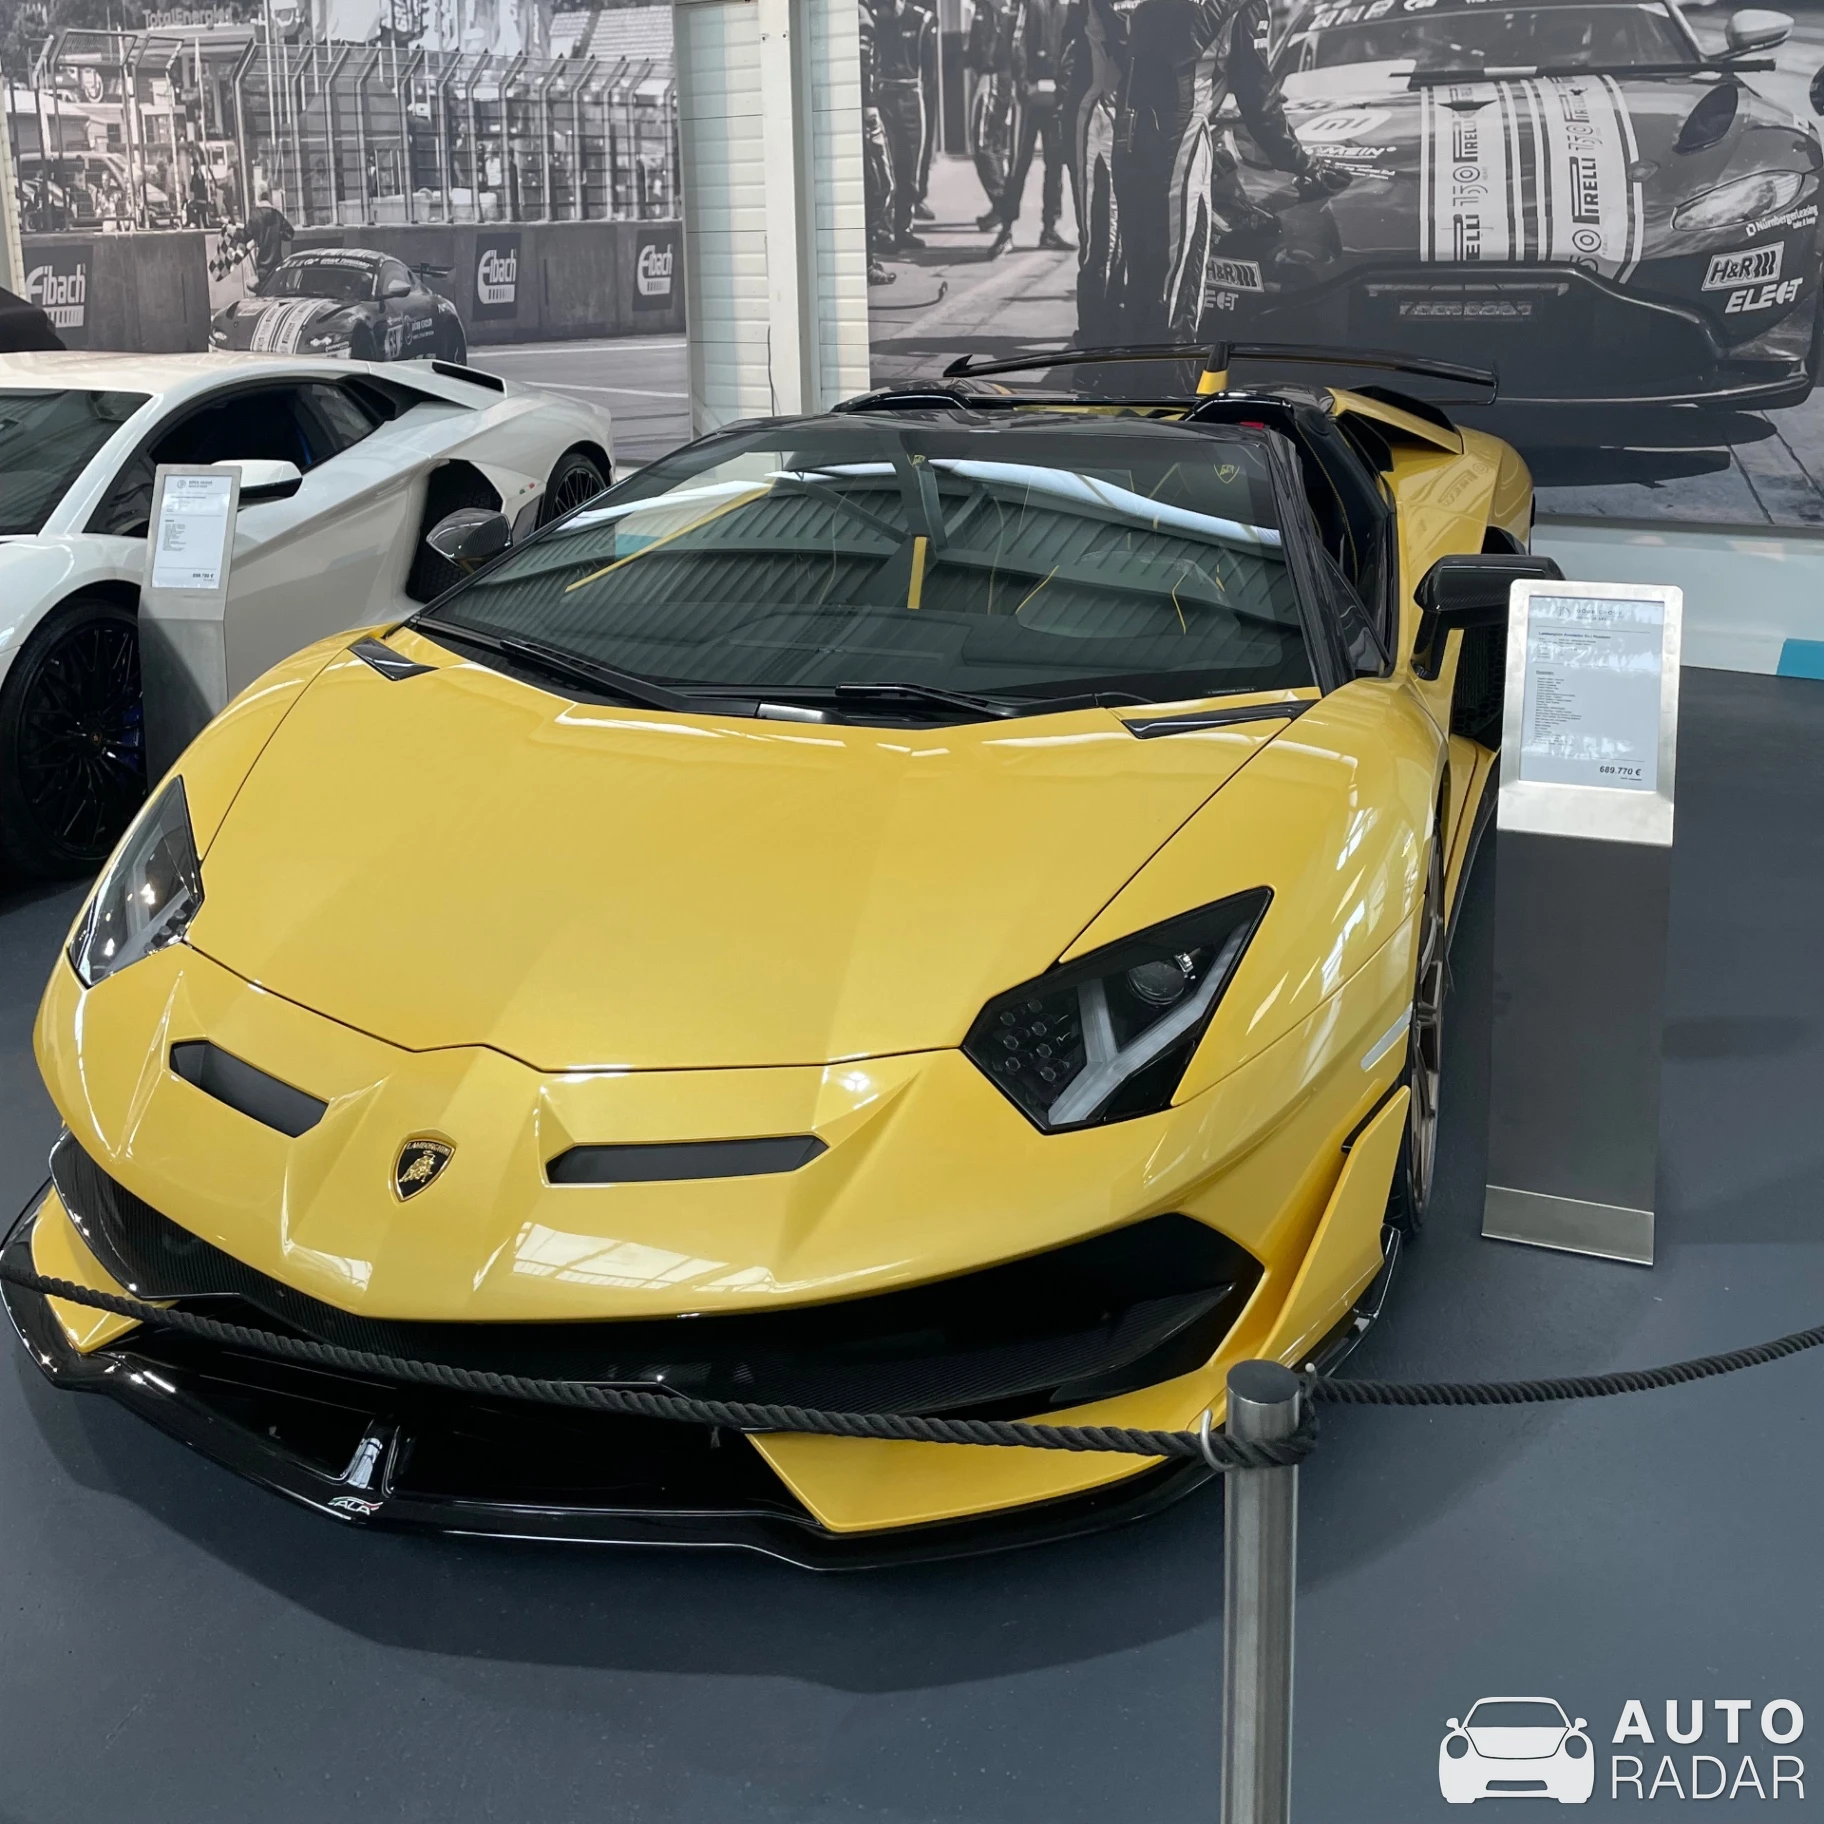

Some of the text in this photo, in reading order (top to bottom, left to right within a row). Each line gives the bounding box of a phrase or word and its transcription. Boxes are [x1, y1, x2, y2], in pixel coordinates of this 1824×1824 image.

[1569, 156, 1600, 225] PIRELLI
[477, 248, 517, 304] Eibach
[1710, 257, 1754, 283] H&R
[1600, 765, 1642, 776] 689.770 €
[406, 1141, 452, 1157] LAMBORGHINI
